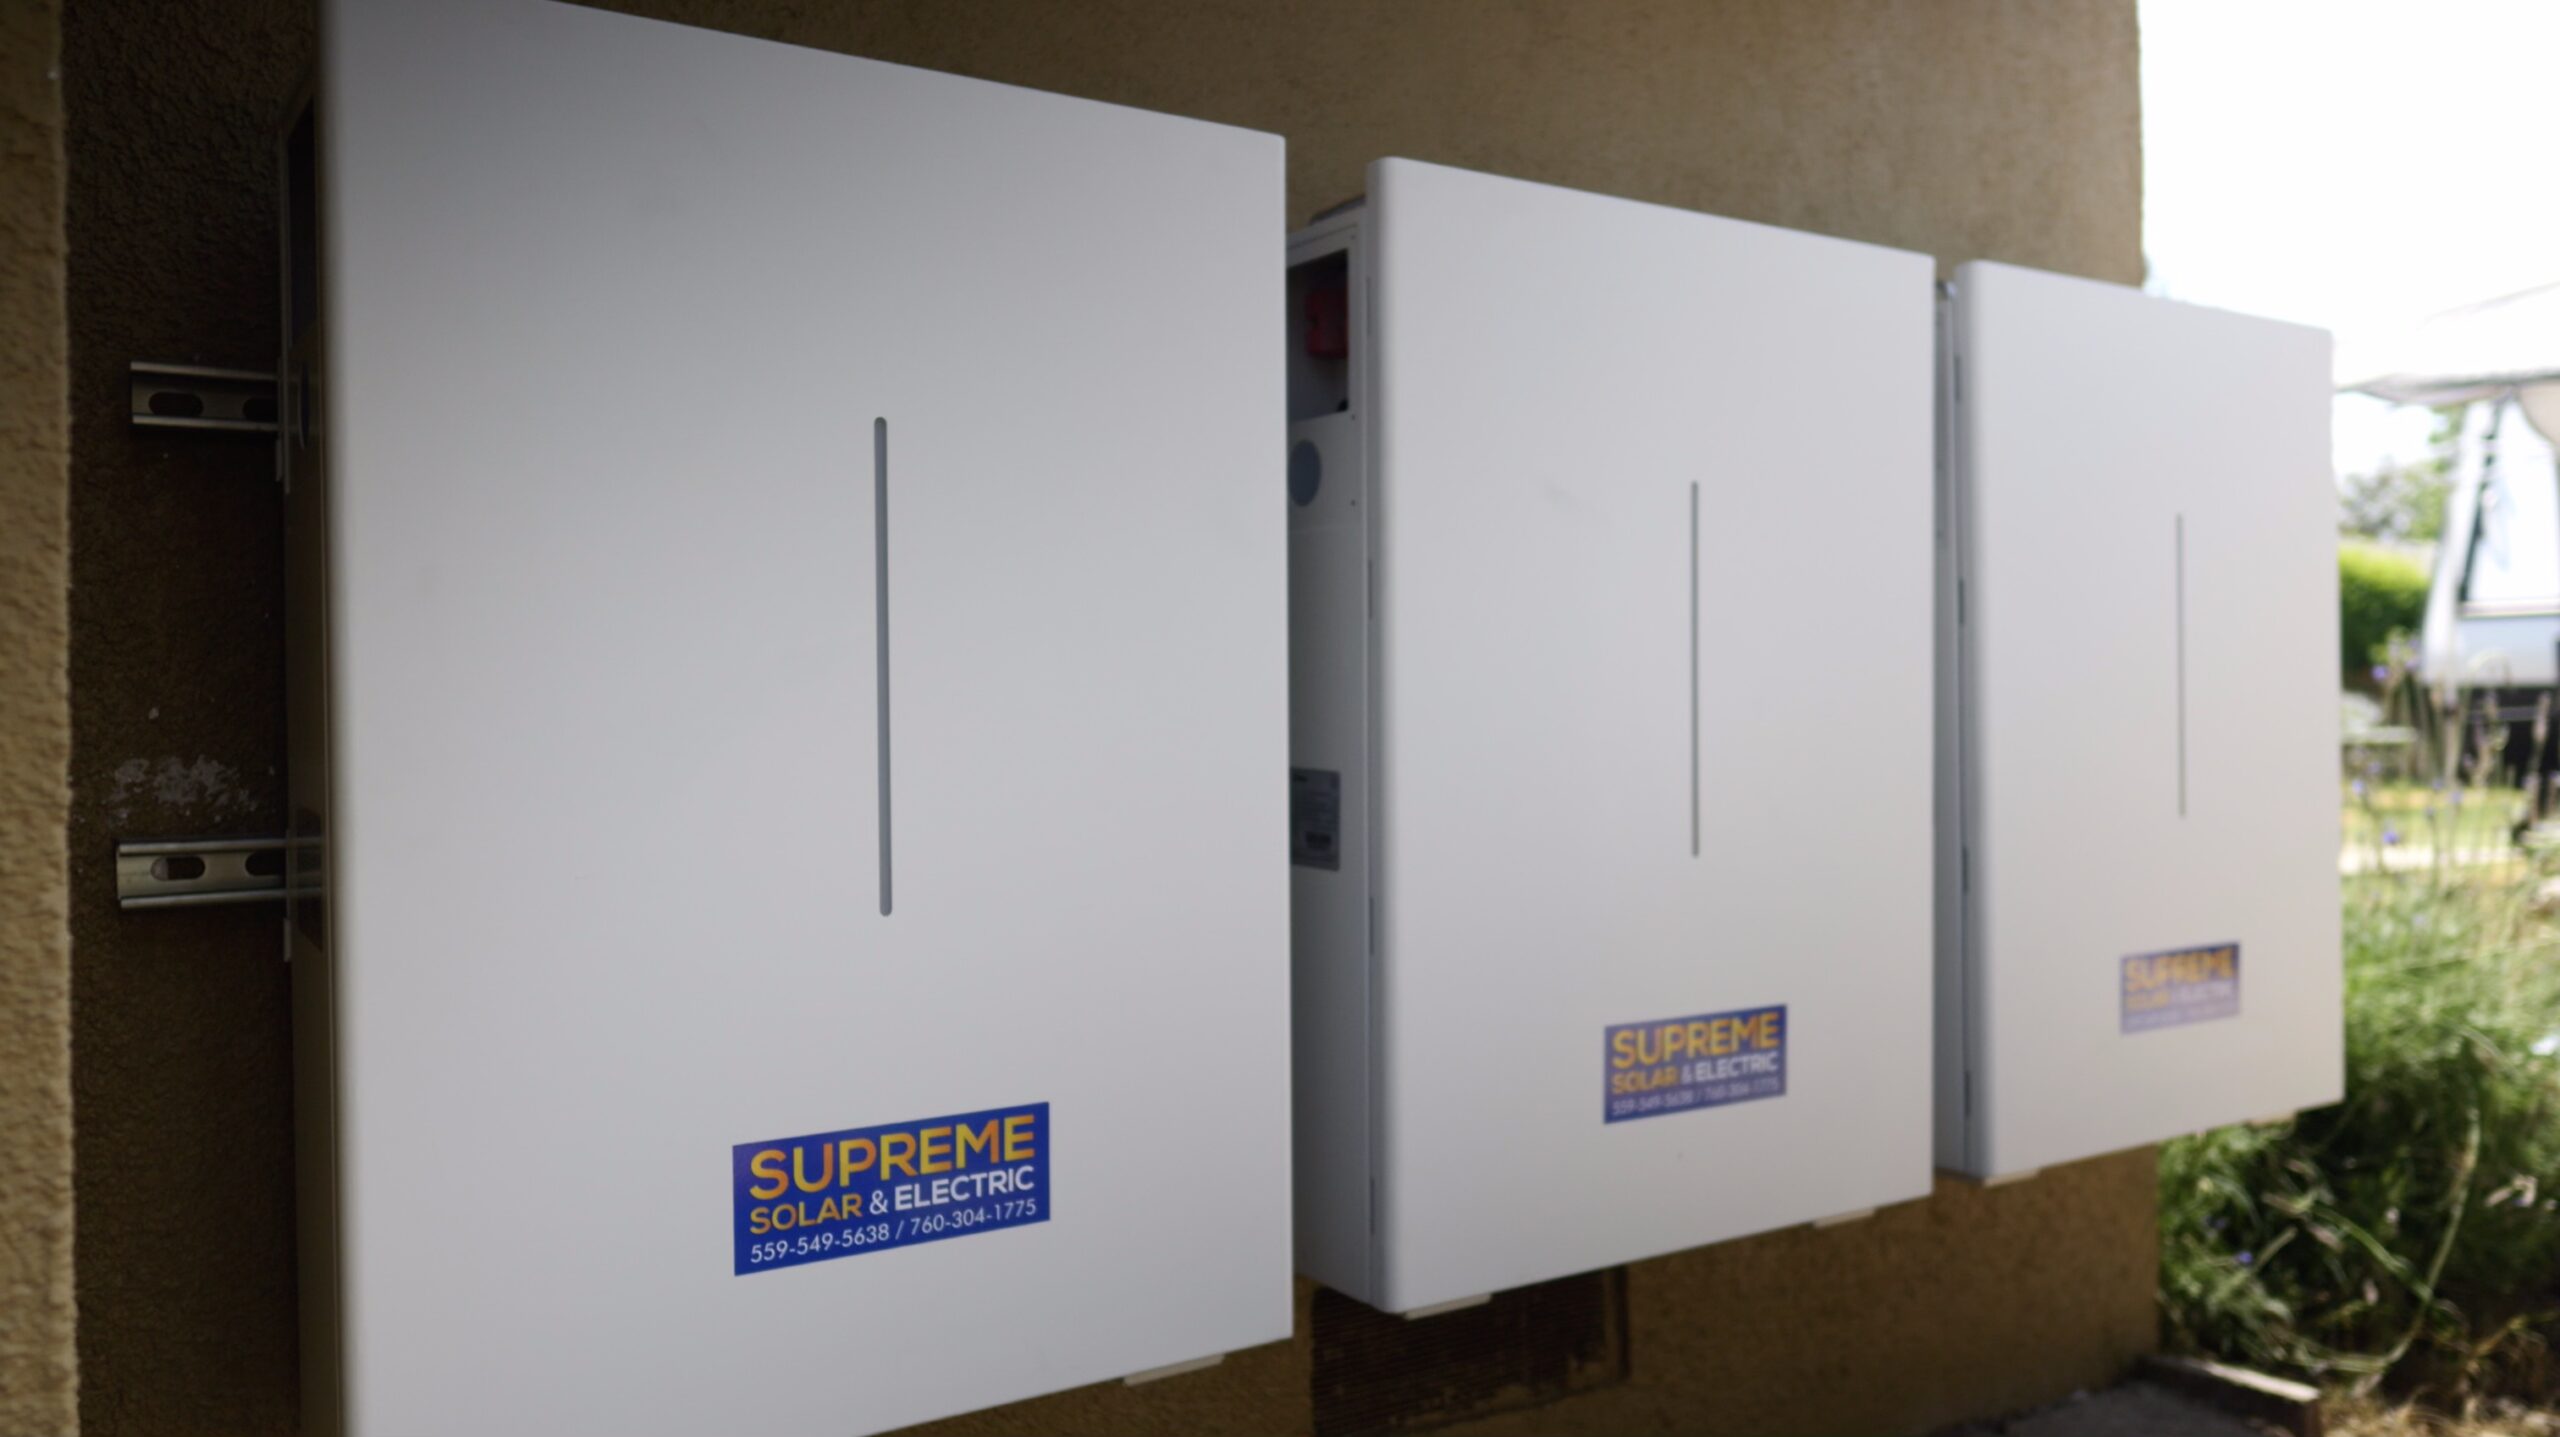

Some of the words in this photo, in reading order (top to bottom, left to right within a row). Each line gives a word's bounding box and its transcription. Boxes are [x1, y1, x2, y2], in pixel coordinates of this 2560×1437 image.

[1611, 1066, 1677, 1094] SOLAR
[1695, 1051, 1778, 1082] ELECTRIC
[1612, 1012, 1780, 1069] SUPREME
[749, 1114, 1035, 1200] SUPREME
[749, 1193, 863, 1234] SOLAR
[869, 1189, 888, 1215] &
[895, 1165, 1034, 1211] ELECTRIC
[750, 1223, 889, 1263] 559-549-5638
[910, 1198, 1037, 1236] 760-304-1775
